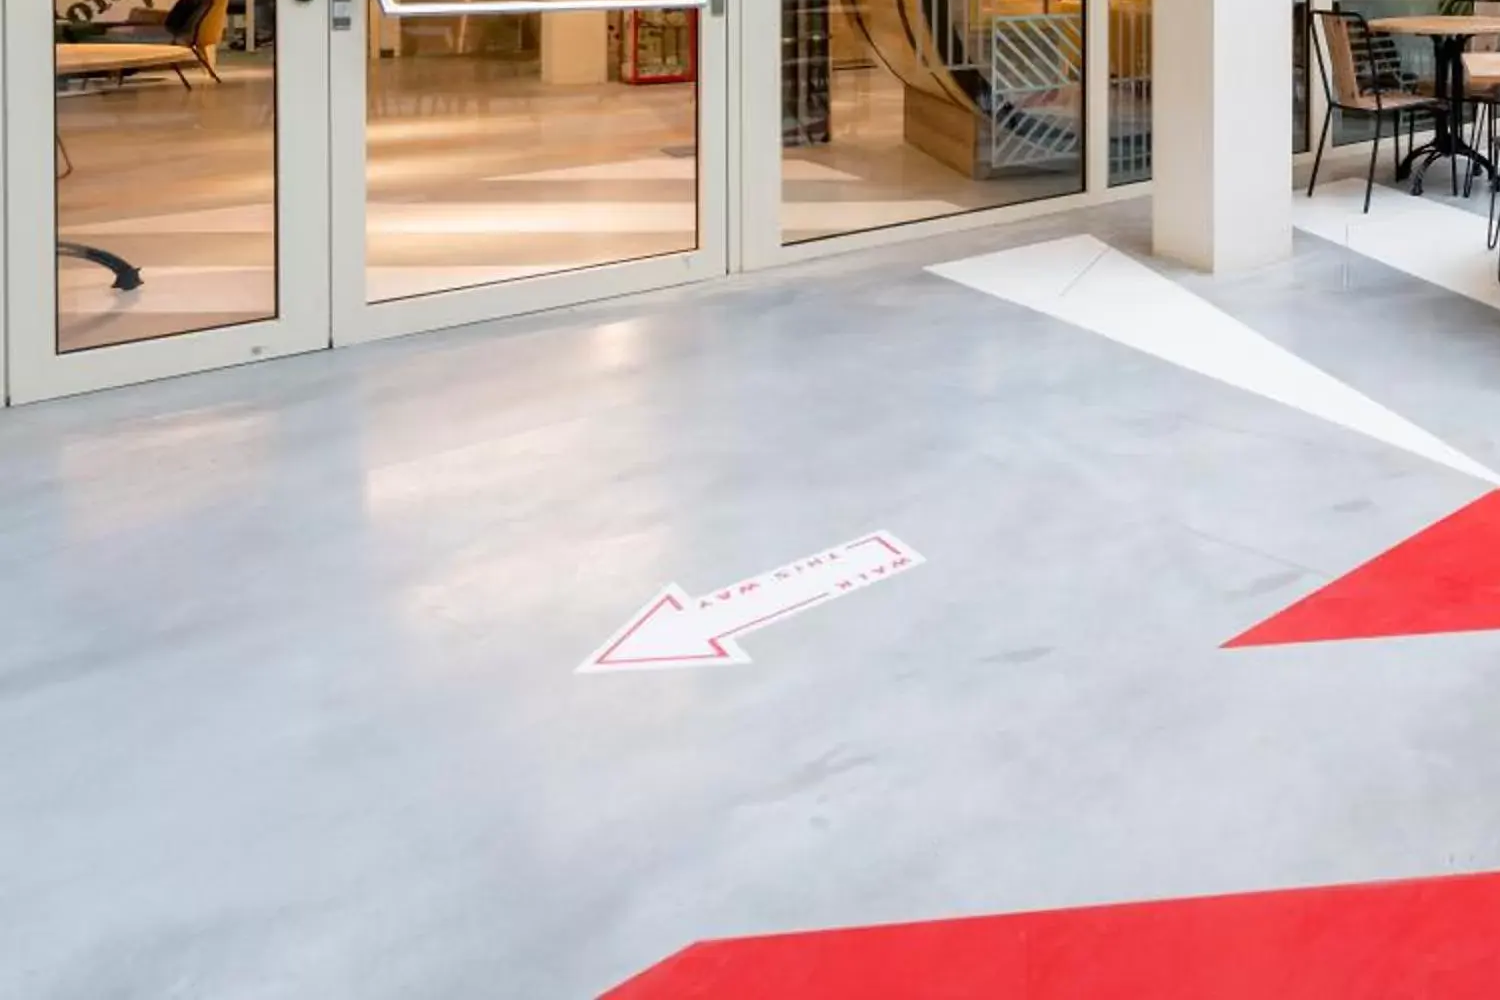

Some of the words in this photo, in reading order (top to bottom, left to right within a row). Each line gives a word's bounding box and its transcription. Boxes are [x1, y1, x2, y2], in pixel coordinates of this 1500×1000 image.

[774, 553, 838, 579] THIS
[837, 557, 910, 589] WALK
[699, 583, 759, 608] WAY
